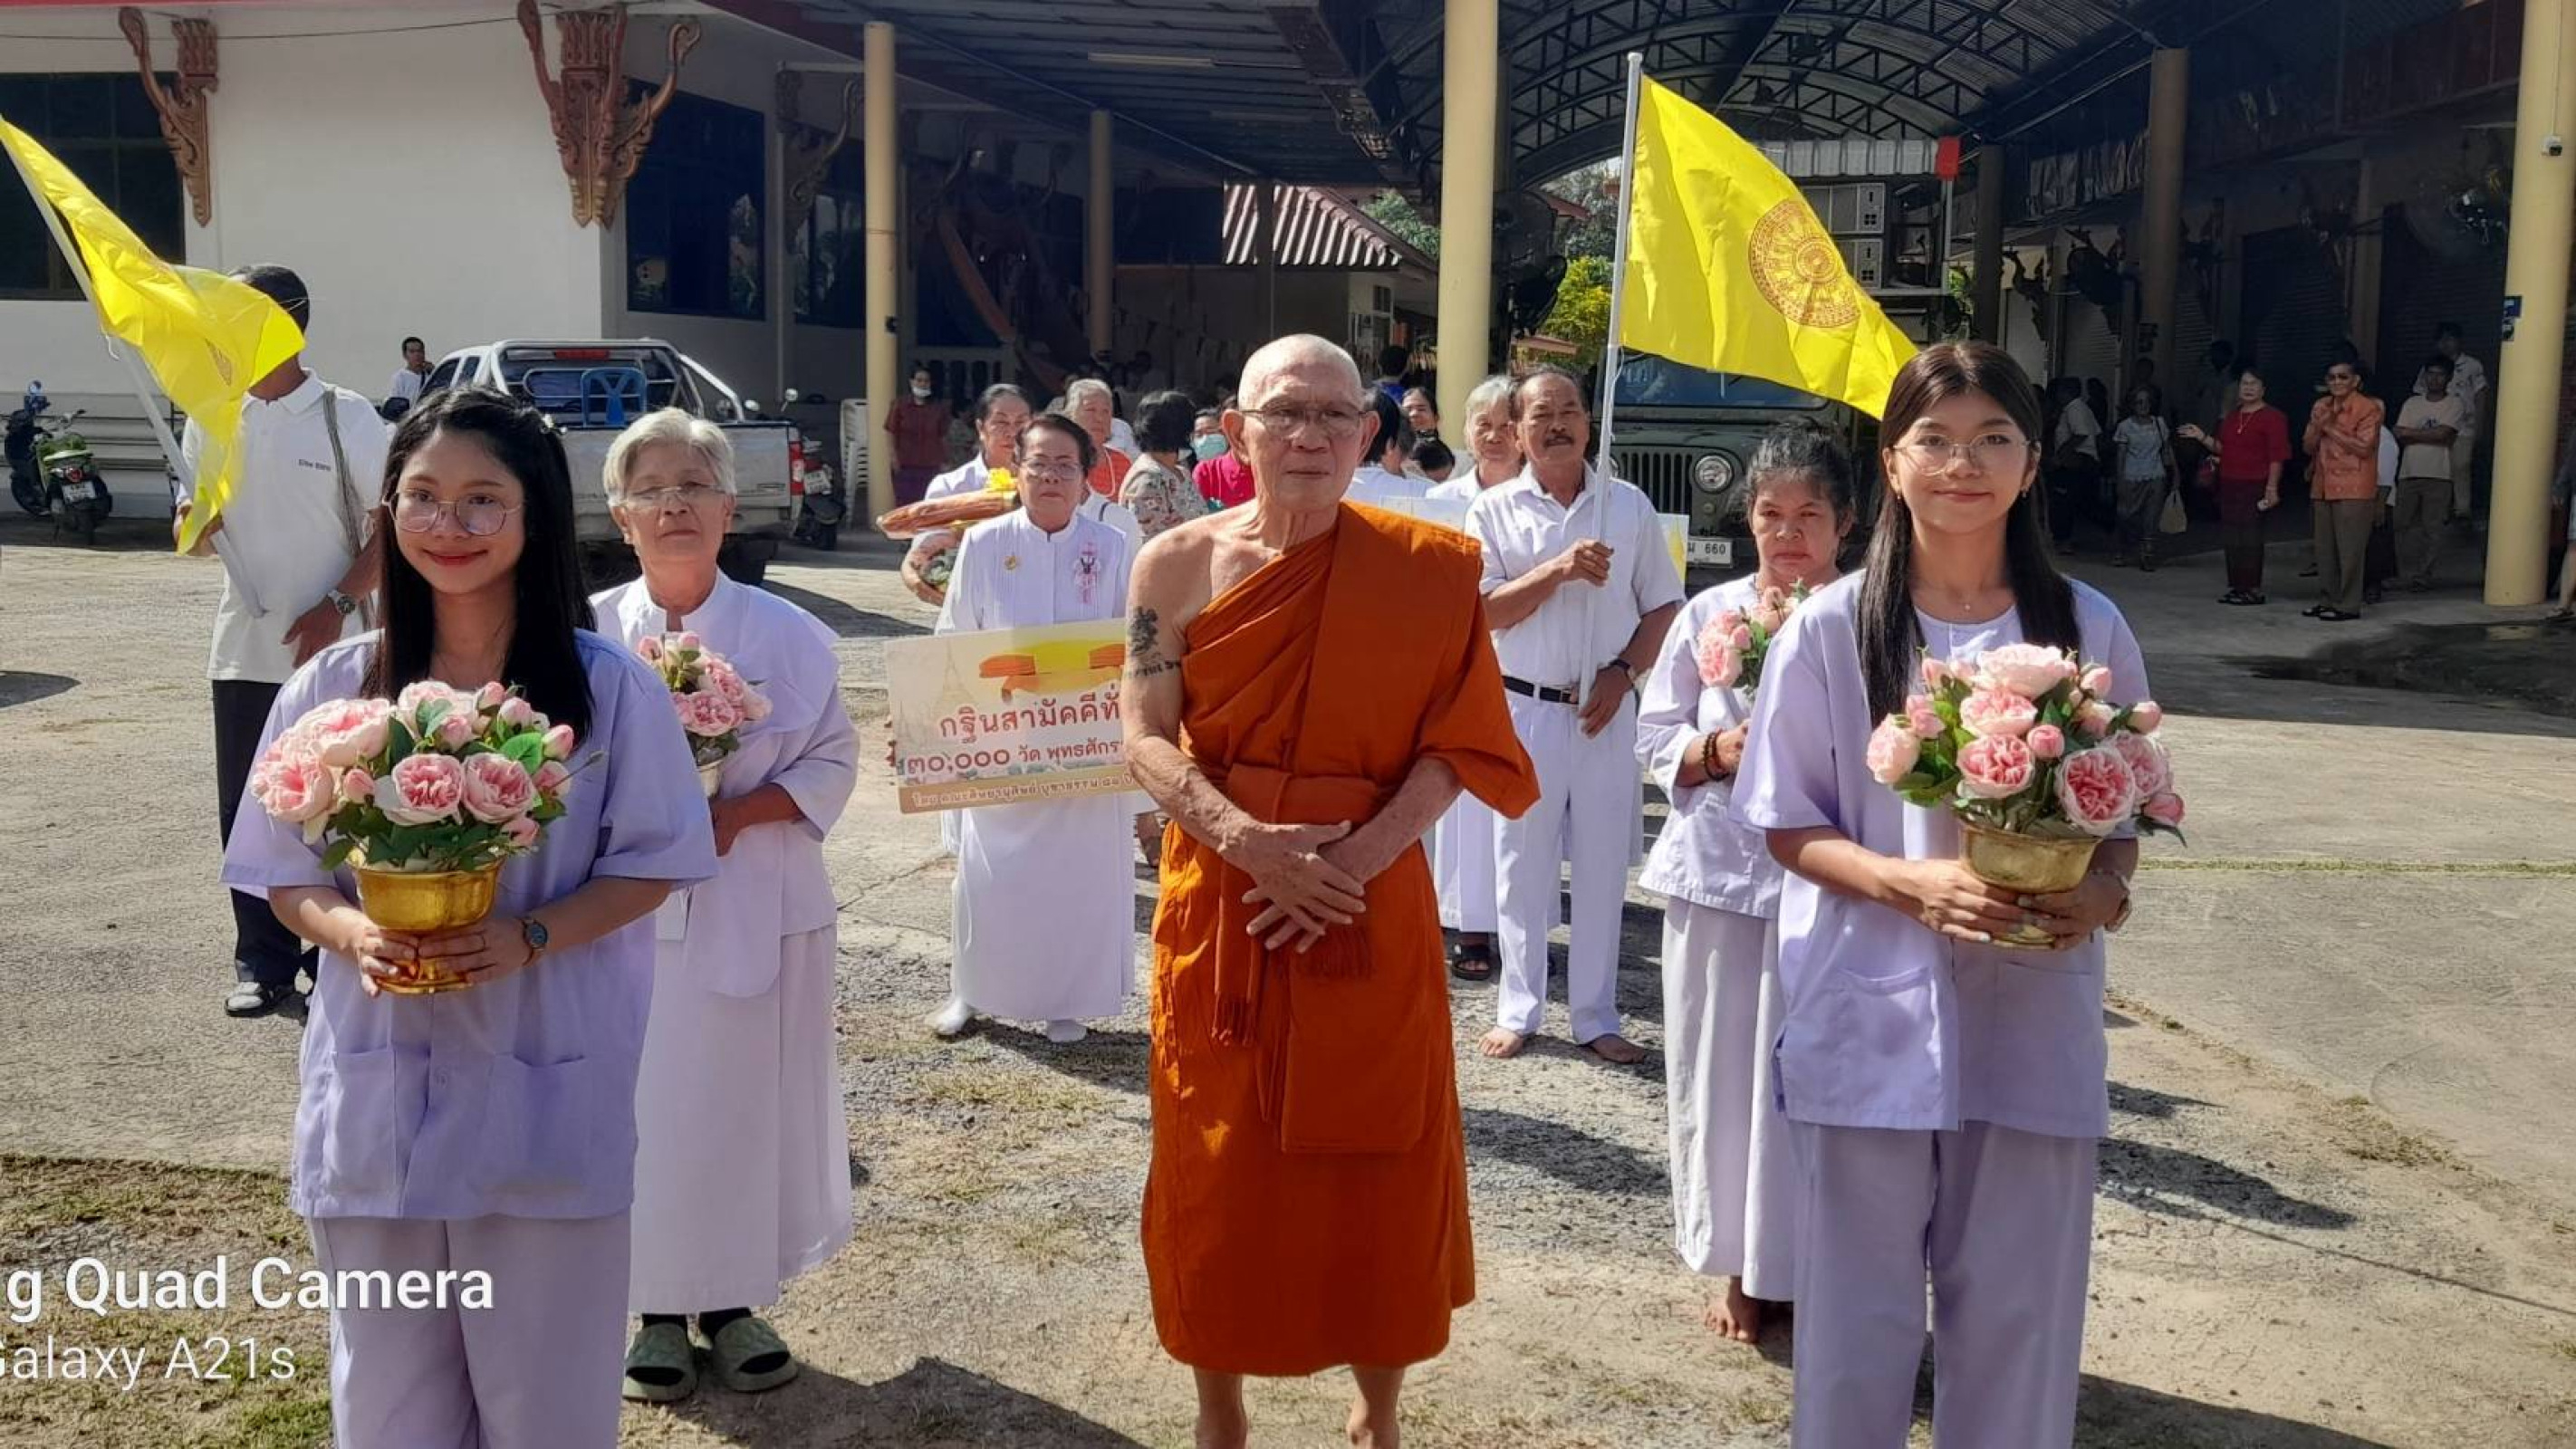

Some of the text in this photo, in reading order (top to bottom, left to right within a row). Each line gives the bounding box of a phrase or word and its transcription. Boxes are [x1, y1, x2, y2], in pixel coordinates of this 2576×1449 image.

[939, 683, 1120, 744] กฐินสามัคคีทั่
[1017, 744, 1041, 763] วัด
[1046, 737, 1123, 765] พุทธศักร
